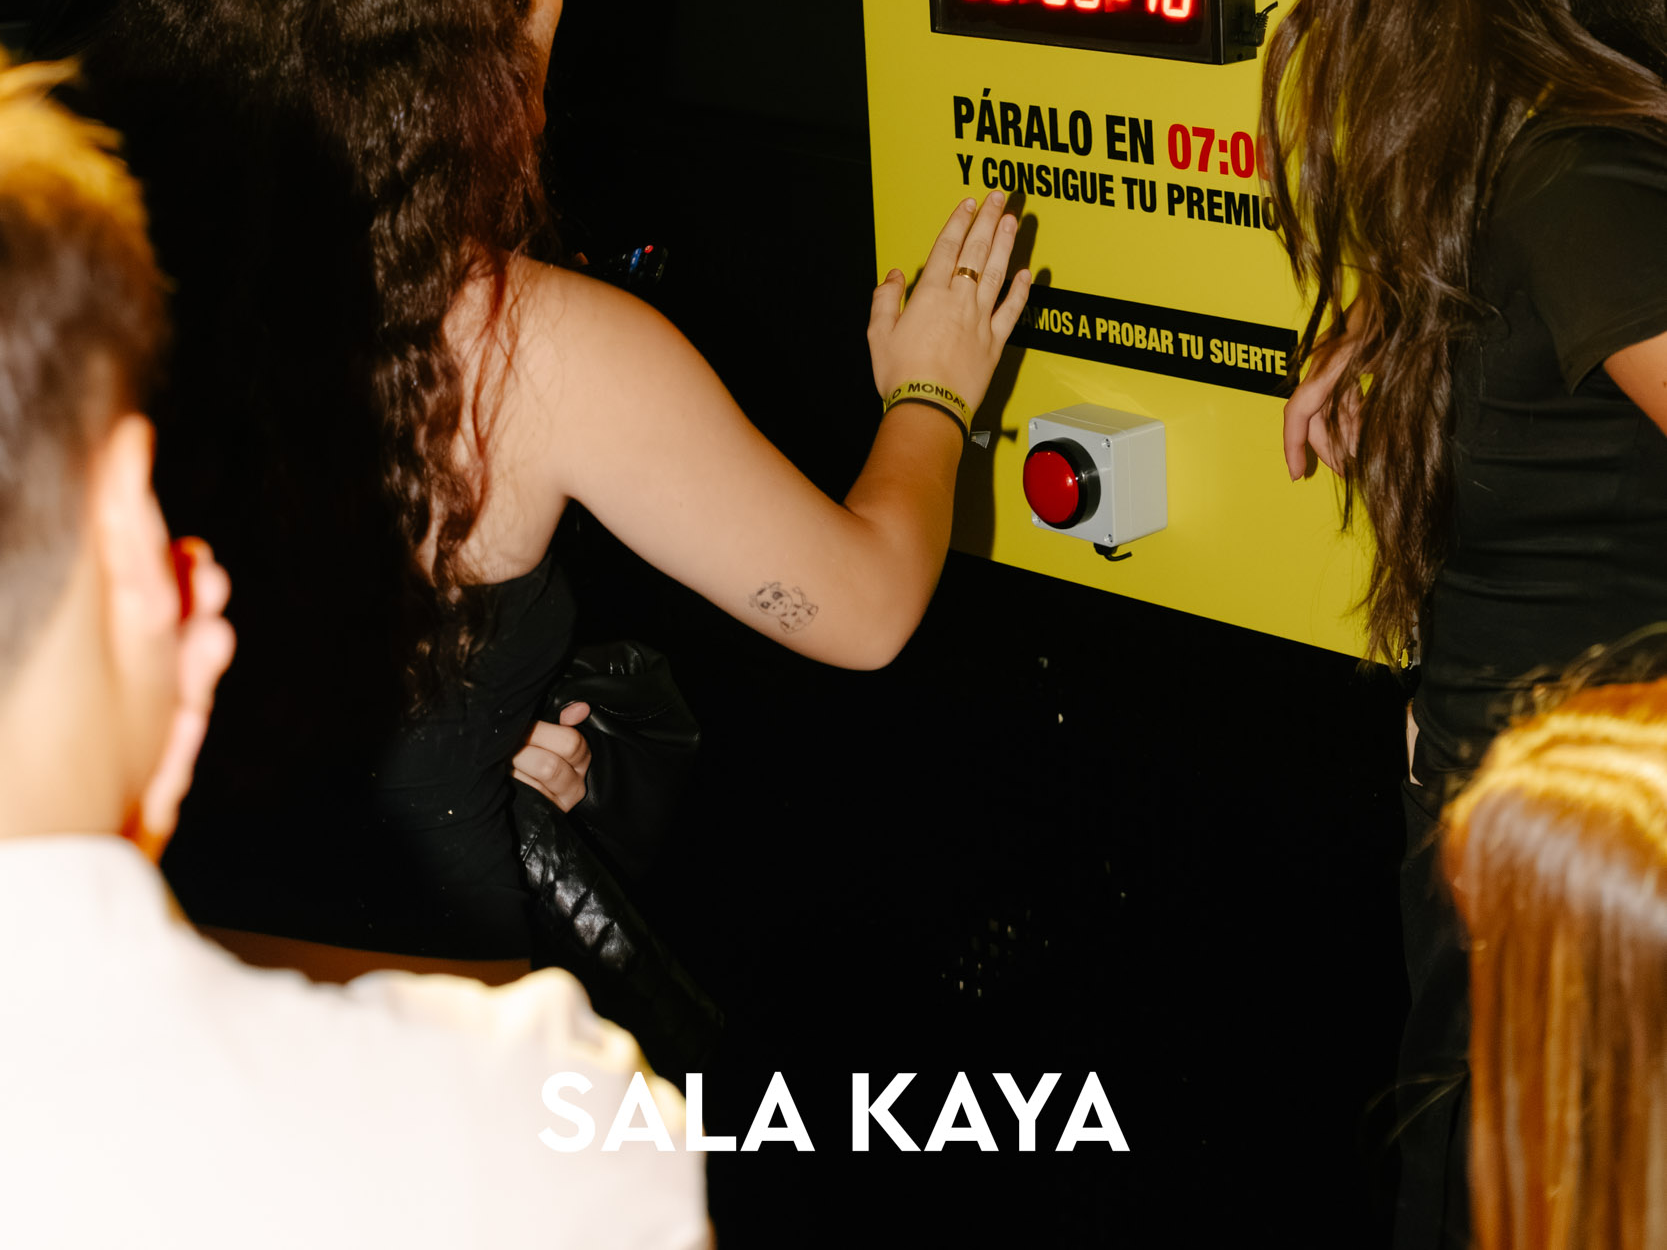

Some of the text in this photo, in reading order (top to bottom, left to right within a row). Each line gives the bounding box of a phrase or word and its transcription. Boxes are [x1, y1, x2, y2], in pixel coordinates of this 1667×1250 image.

[953, 88, 1093, 157] PÁRALO
[1105, 114, 1154, 165] EN
[957, 153, 1281, 231] Y CONSIGUE TU PREMIO
[1020, 306, 1288, 377] AMOS A PROBAR TU SUERTE
